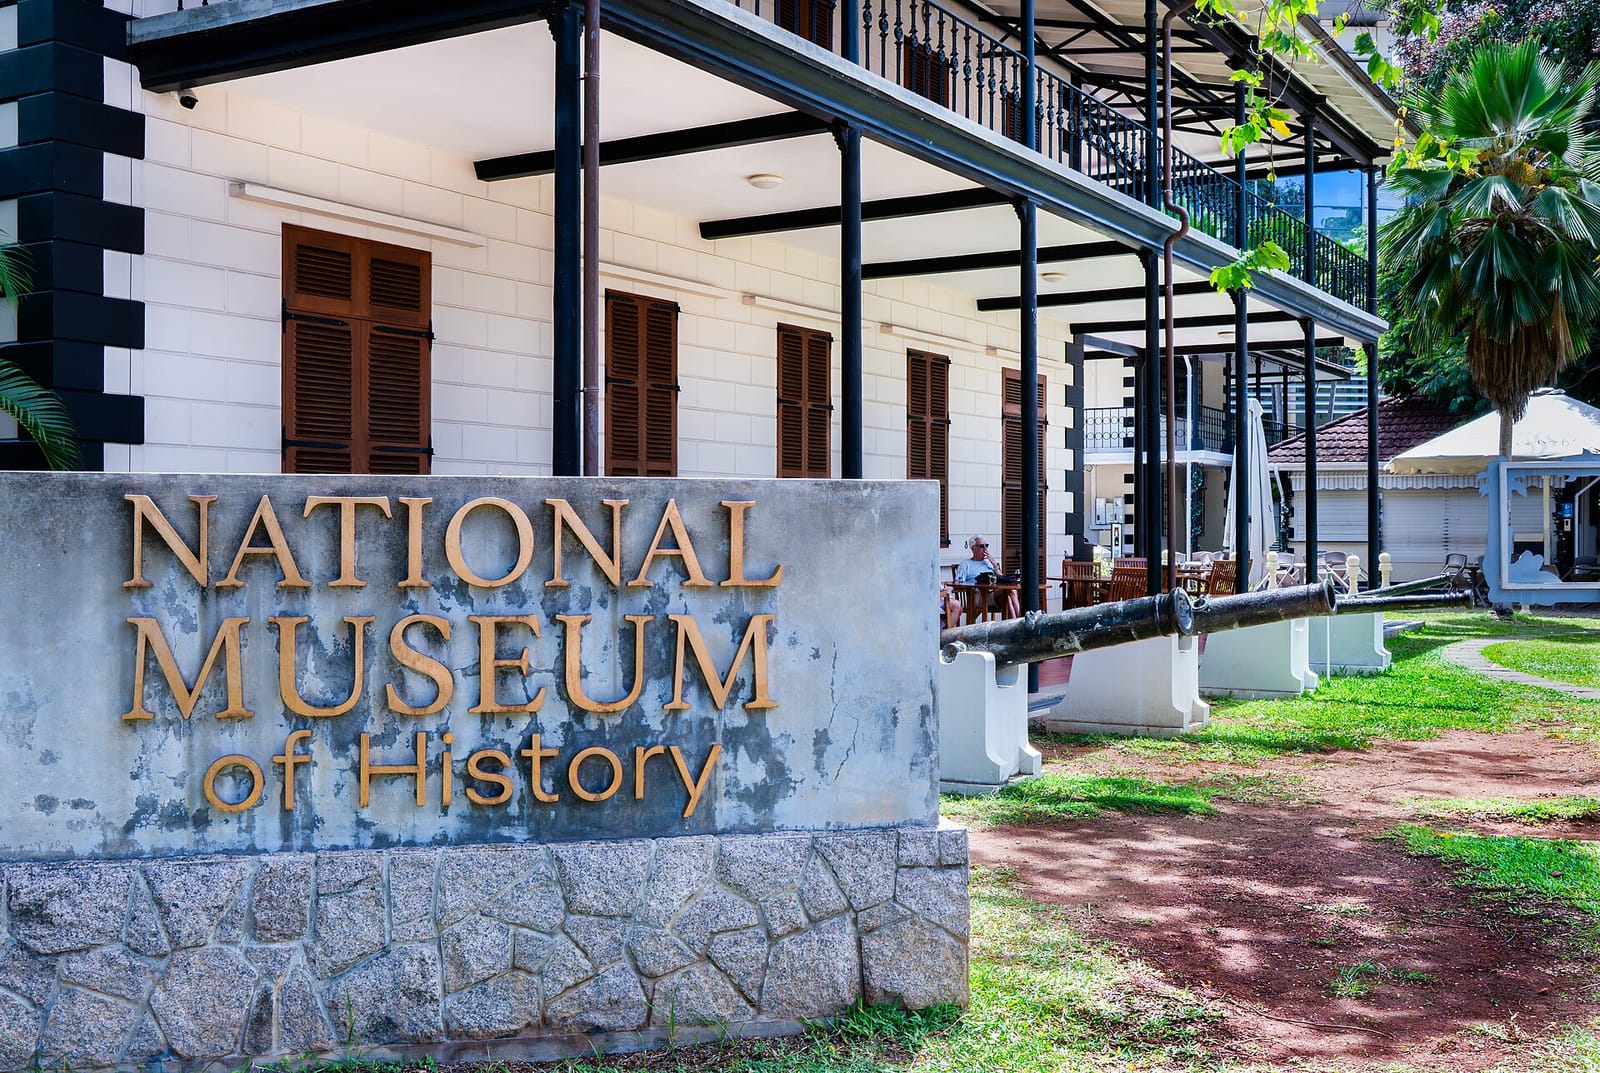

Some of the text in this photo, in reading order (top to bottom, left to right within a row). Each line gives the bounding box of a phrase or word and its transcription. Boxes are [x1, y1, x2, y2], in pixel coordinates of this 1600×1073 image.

[122, 494, 783, 590] NATIONAL
[121, 615, 778, 721] MUSEUM
[204, 729, 721, 818] of History
